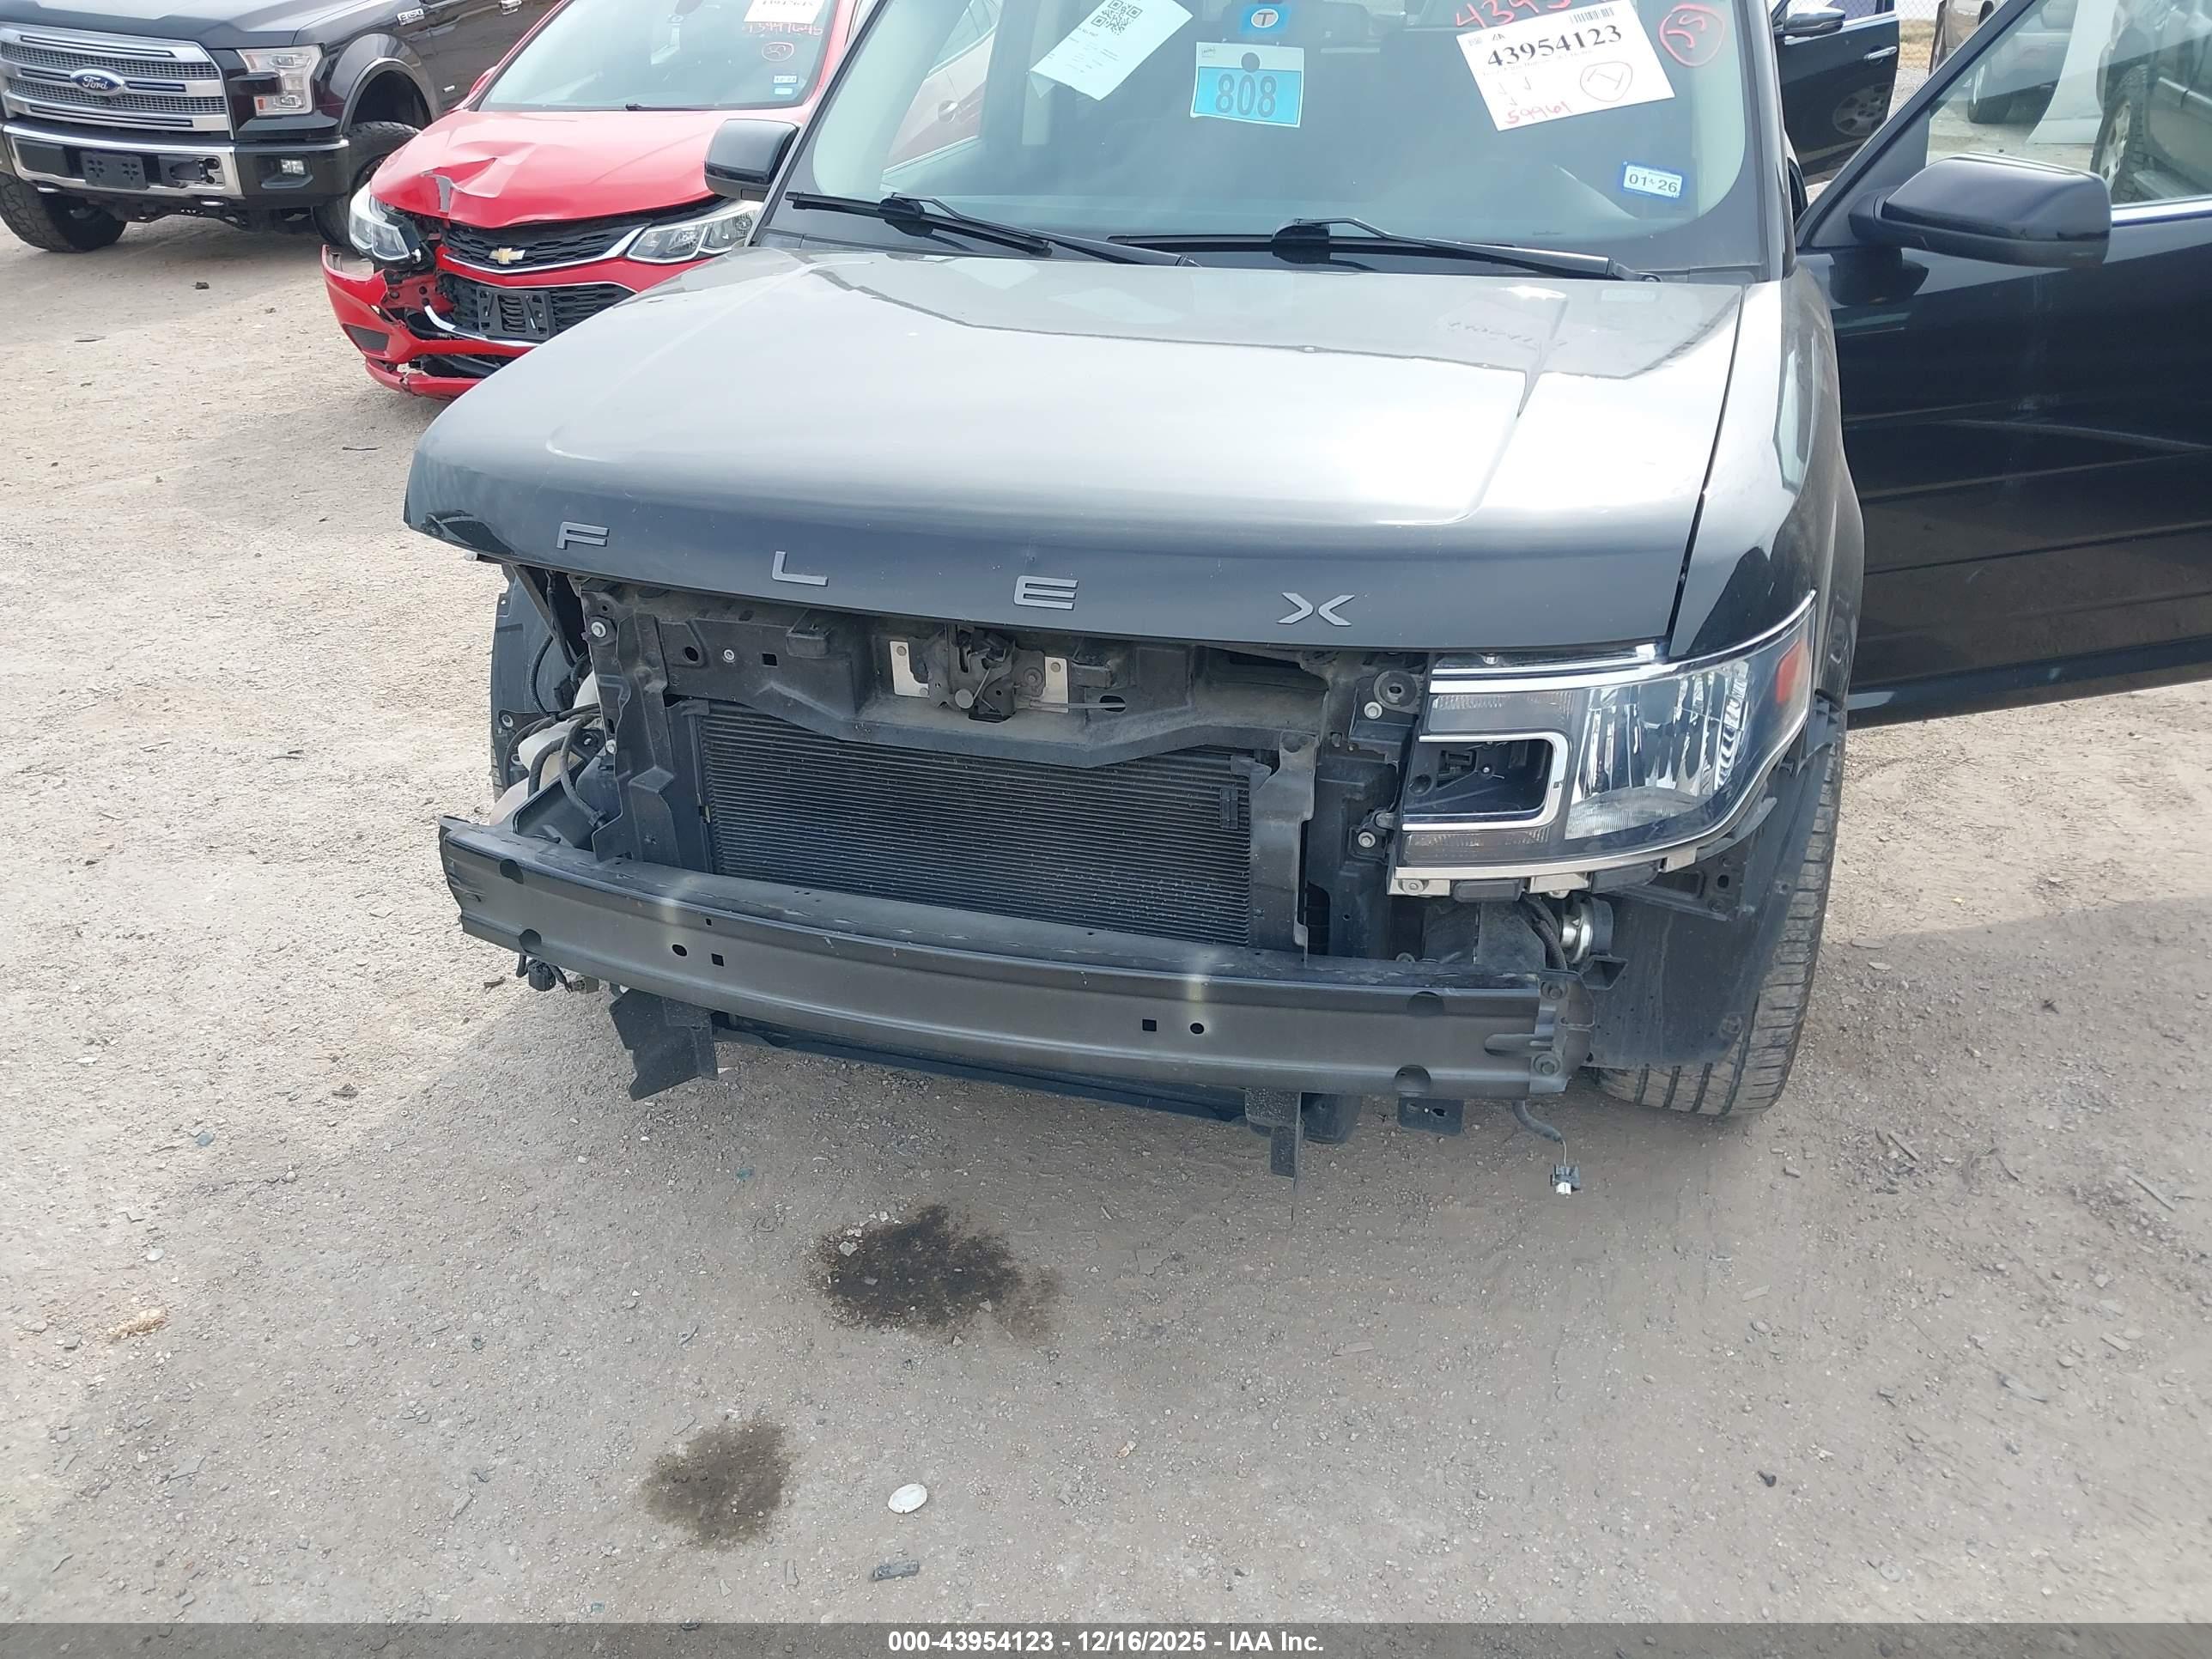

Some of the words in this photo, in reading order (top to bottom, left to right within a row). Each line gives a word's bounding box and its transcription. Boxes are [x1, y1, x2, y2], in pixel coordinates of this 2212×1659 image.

[1256, 12, 1274, 27] T
[1487, 24, 1622, 66] 43954123
[82, 75, 109, 90] Ford
[1215, 73, 1277, 118] 808
[1628, 173, 1648, 186] 01
[1657, 179, 1679, 193] 26
[555, 520, 1356, 628] FLEX
